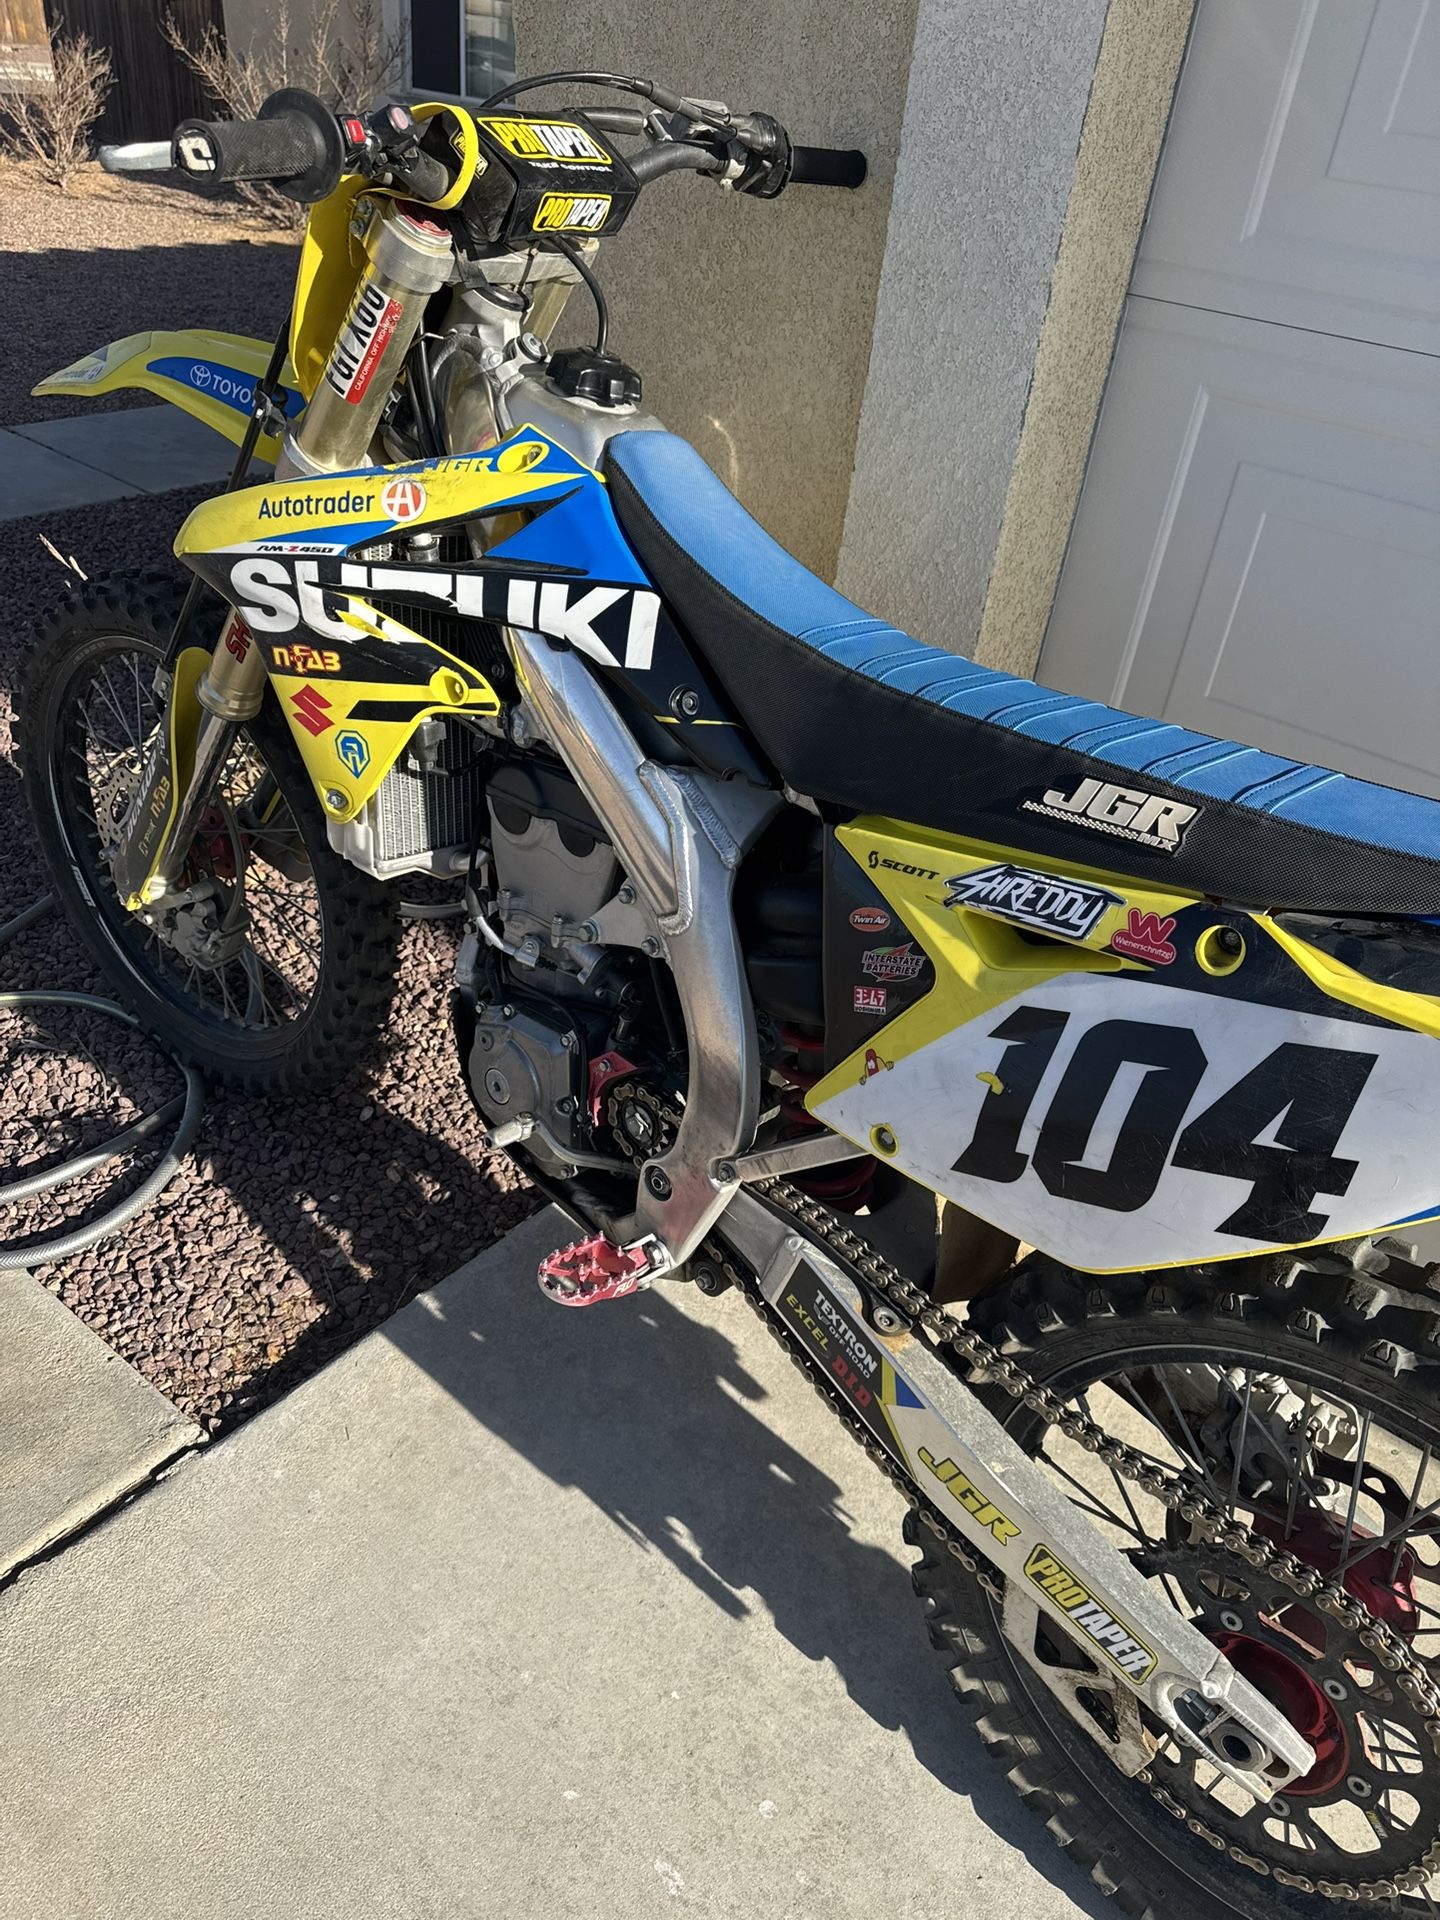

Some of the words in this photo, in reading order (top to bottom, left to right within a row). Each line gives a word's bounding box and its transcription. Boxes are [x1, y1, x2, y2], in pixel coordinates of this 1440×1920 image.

[489, 122, 606, 161] PROTAPER
[536, 198, 611, 230] PROTAPER
[371, 344, 380, 357] OFF
[258, 491, 375, 519] Autotrader
[256, 545, 335, 554] RM-Z450
[126, 750, 157, 841] DUNLOP
[1042, 777, 1198, 842] JGR
[1137, 832, 1178, 851] MX
[880, 858, 940, 880] SCOTT
[853, 914, 873, 924] Twin
[874, 915, 887, 924] Air
[864, 954, 922, 966] INTERSTATE
[865, 964, 918, 976] BATTERIES
[950, 1005, 1379, 1244] 104
[786, 1293, 829, 1351] EXCEL
[815, 1289, 878, 1373] TEXTRON
[829, 1325, 846, 1346] OFF
[846, 1347, 870, 1379] ROAD
[918, 1446, 1022, 1546] JGR
[1029, 1557, 1153, 1675] PROTAPER
